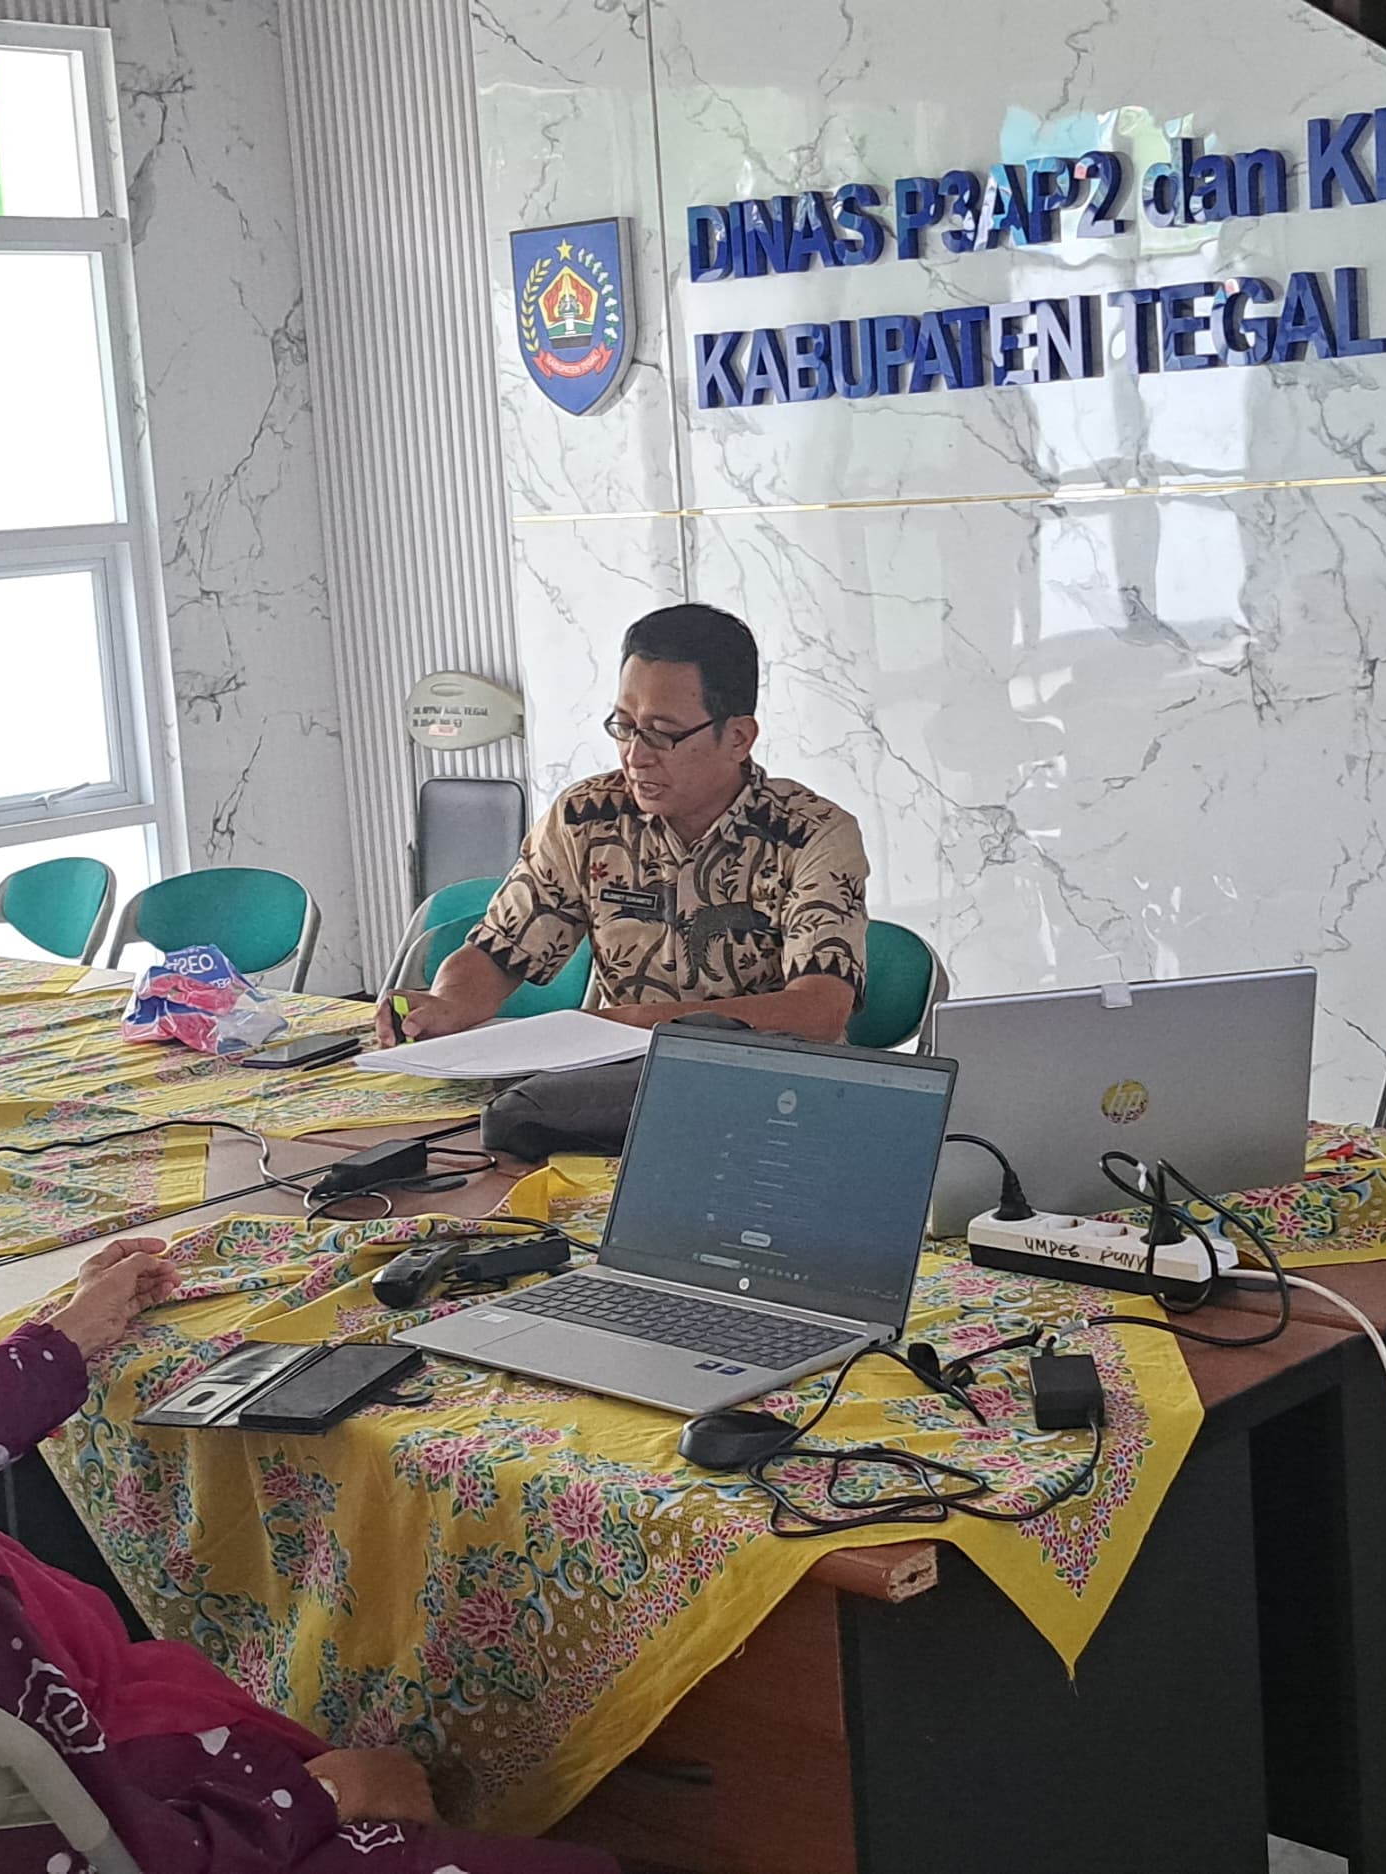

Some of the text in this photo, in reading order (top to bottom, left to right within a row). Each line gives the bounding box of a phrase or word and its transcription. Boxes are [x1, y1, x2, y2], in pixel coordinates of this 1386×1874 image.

[687, 183, 884, 283] DINAS
[895, 150, 1129, 261] P3AP2
[1141, 137, 1288, 229] dan
[693, 294, 1105, 409] KABUPATEN
